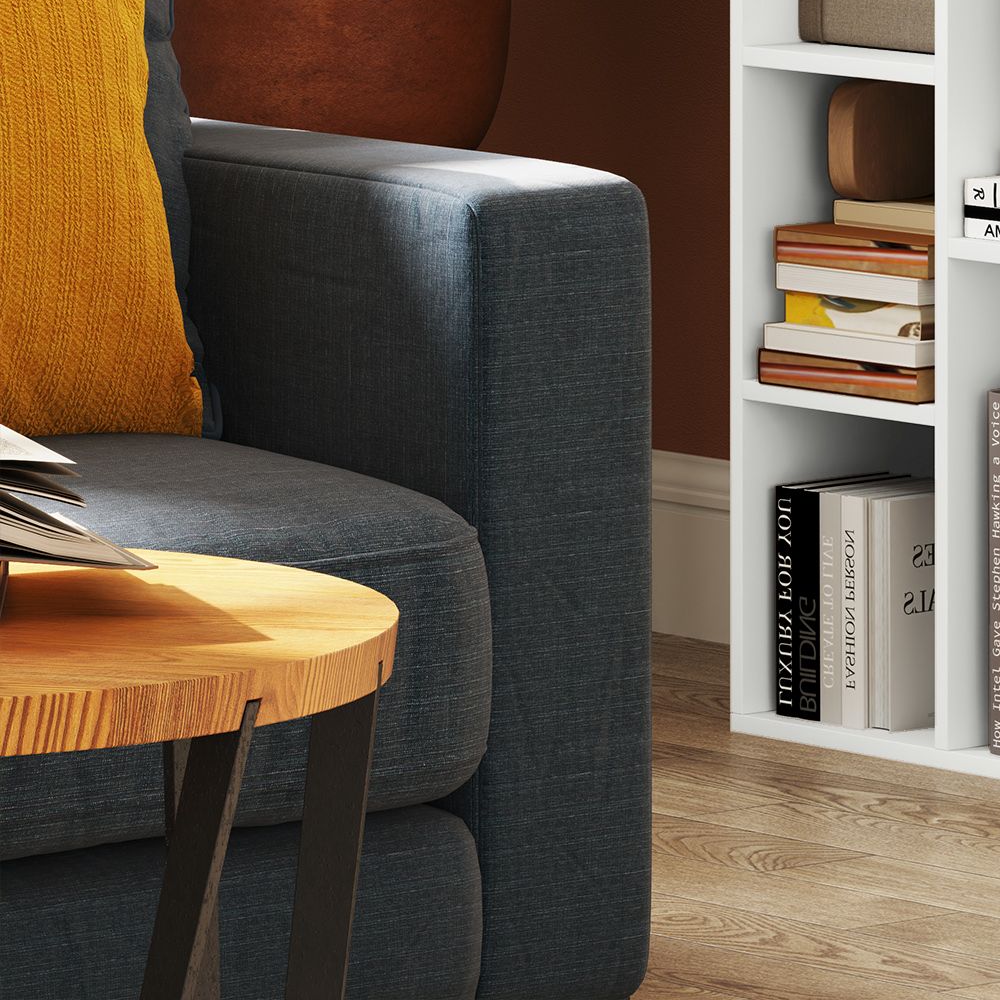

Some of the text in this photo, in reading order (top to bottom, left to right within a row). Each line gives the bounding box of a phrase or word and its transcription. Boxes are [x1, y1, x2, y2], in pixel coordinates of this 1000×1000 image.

[992, 457, 1000, 465] a
[992, 621, 1000, 656] Gave
[992, 667, 1000, 711] Intel
[993, 721, 1000, 748] How
